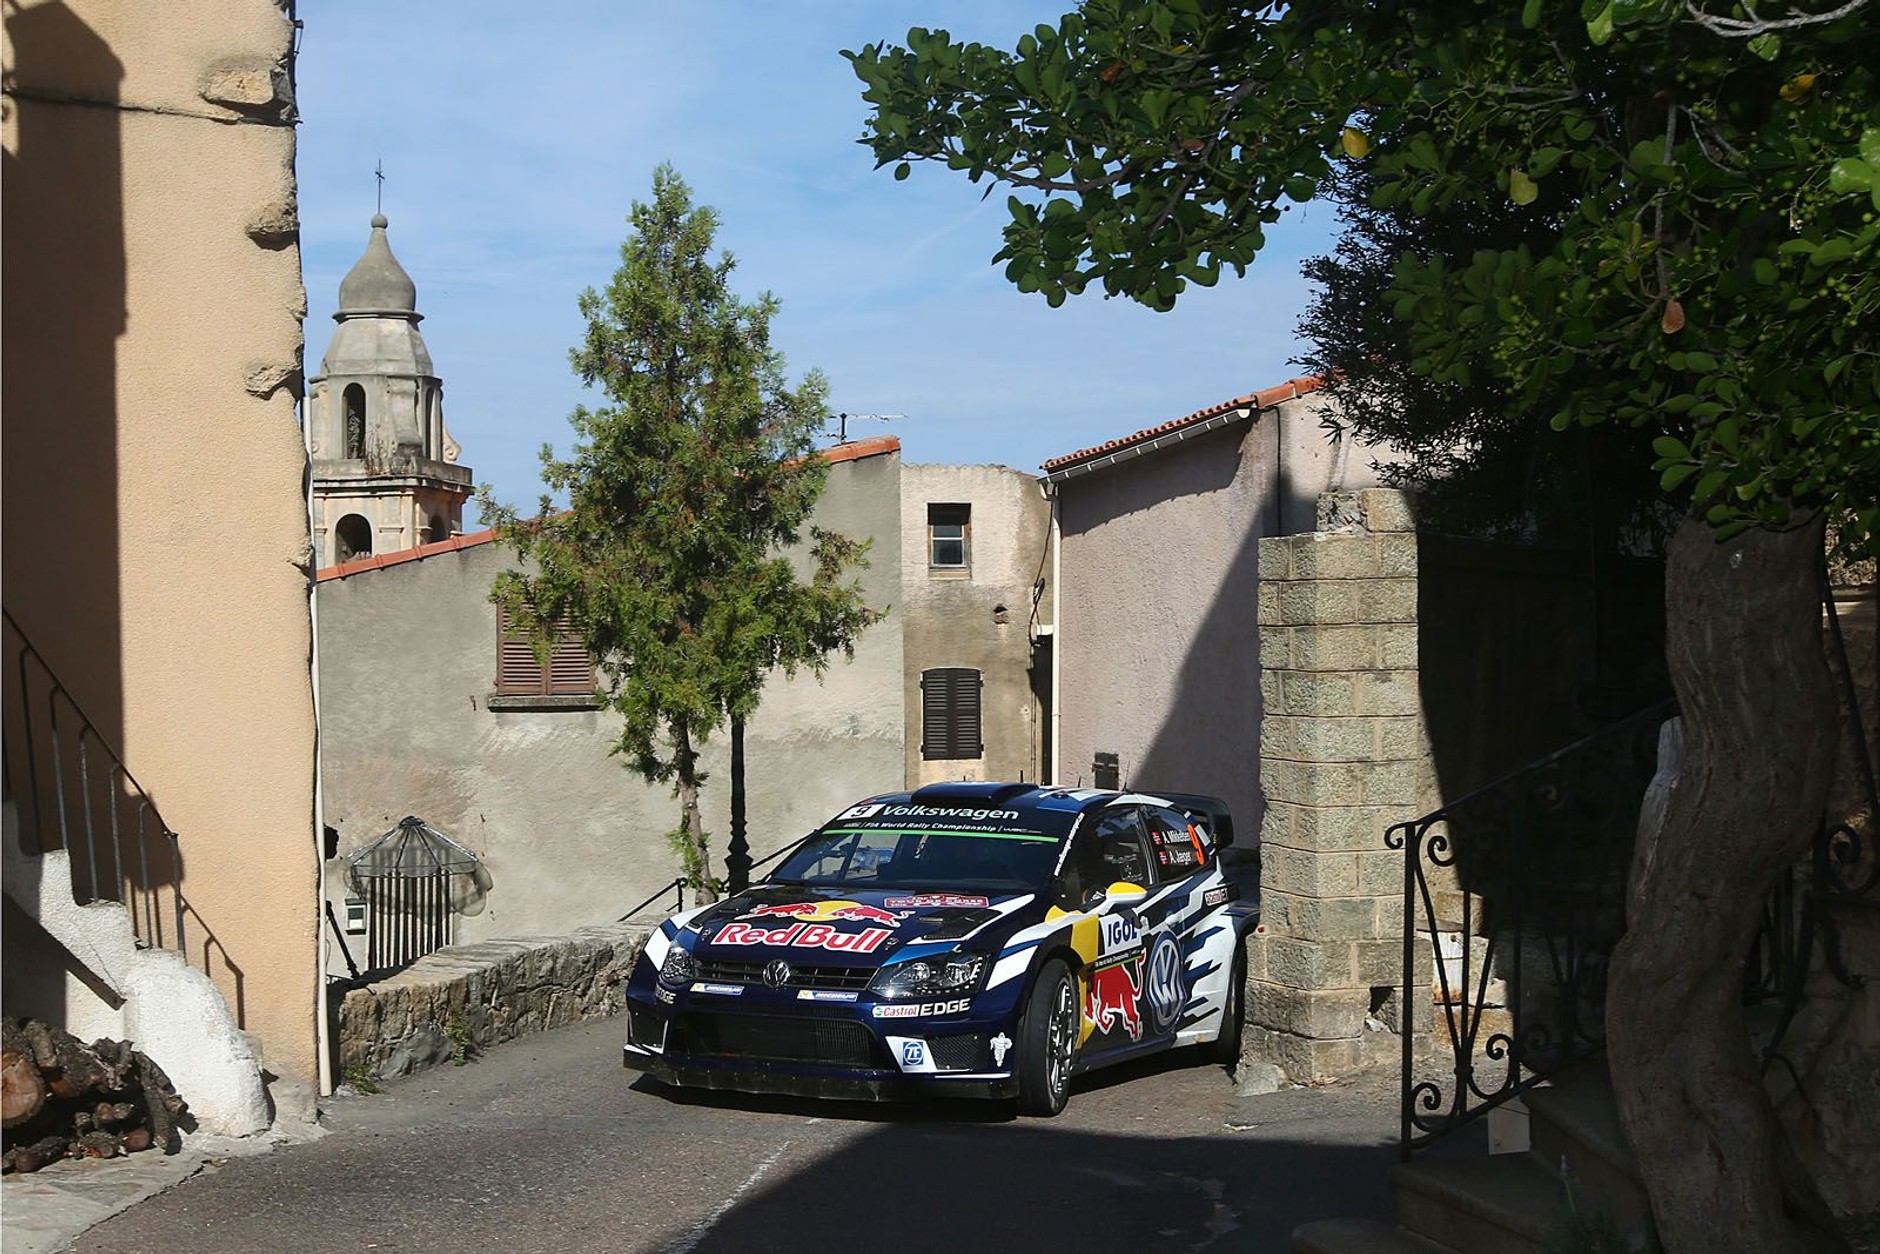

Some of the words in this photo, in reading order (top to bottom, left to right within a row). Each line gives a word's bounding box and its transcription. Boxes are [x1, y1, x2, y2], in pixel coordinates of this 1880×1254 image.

[882, 804, 1019, 821] Volkswagen
[907, 822, 930, 830] Rally
[931, 822, 997, 832] Championship
[1186, 823, 1205, 866] 9
[712, 922, 800, 947] Red
[800, 925, 894, 952] Bull
[883, 1006, 918, 1017] Castrol
[920, 998, 971, 1017] EDGE
[907, 1048, 922, 1060] ZF
